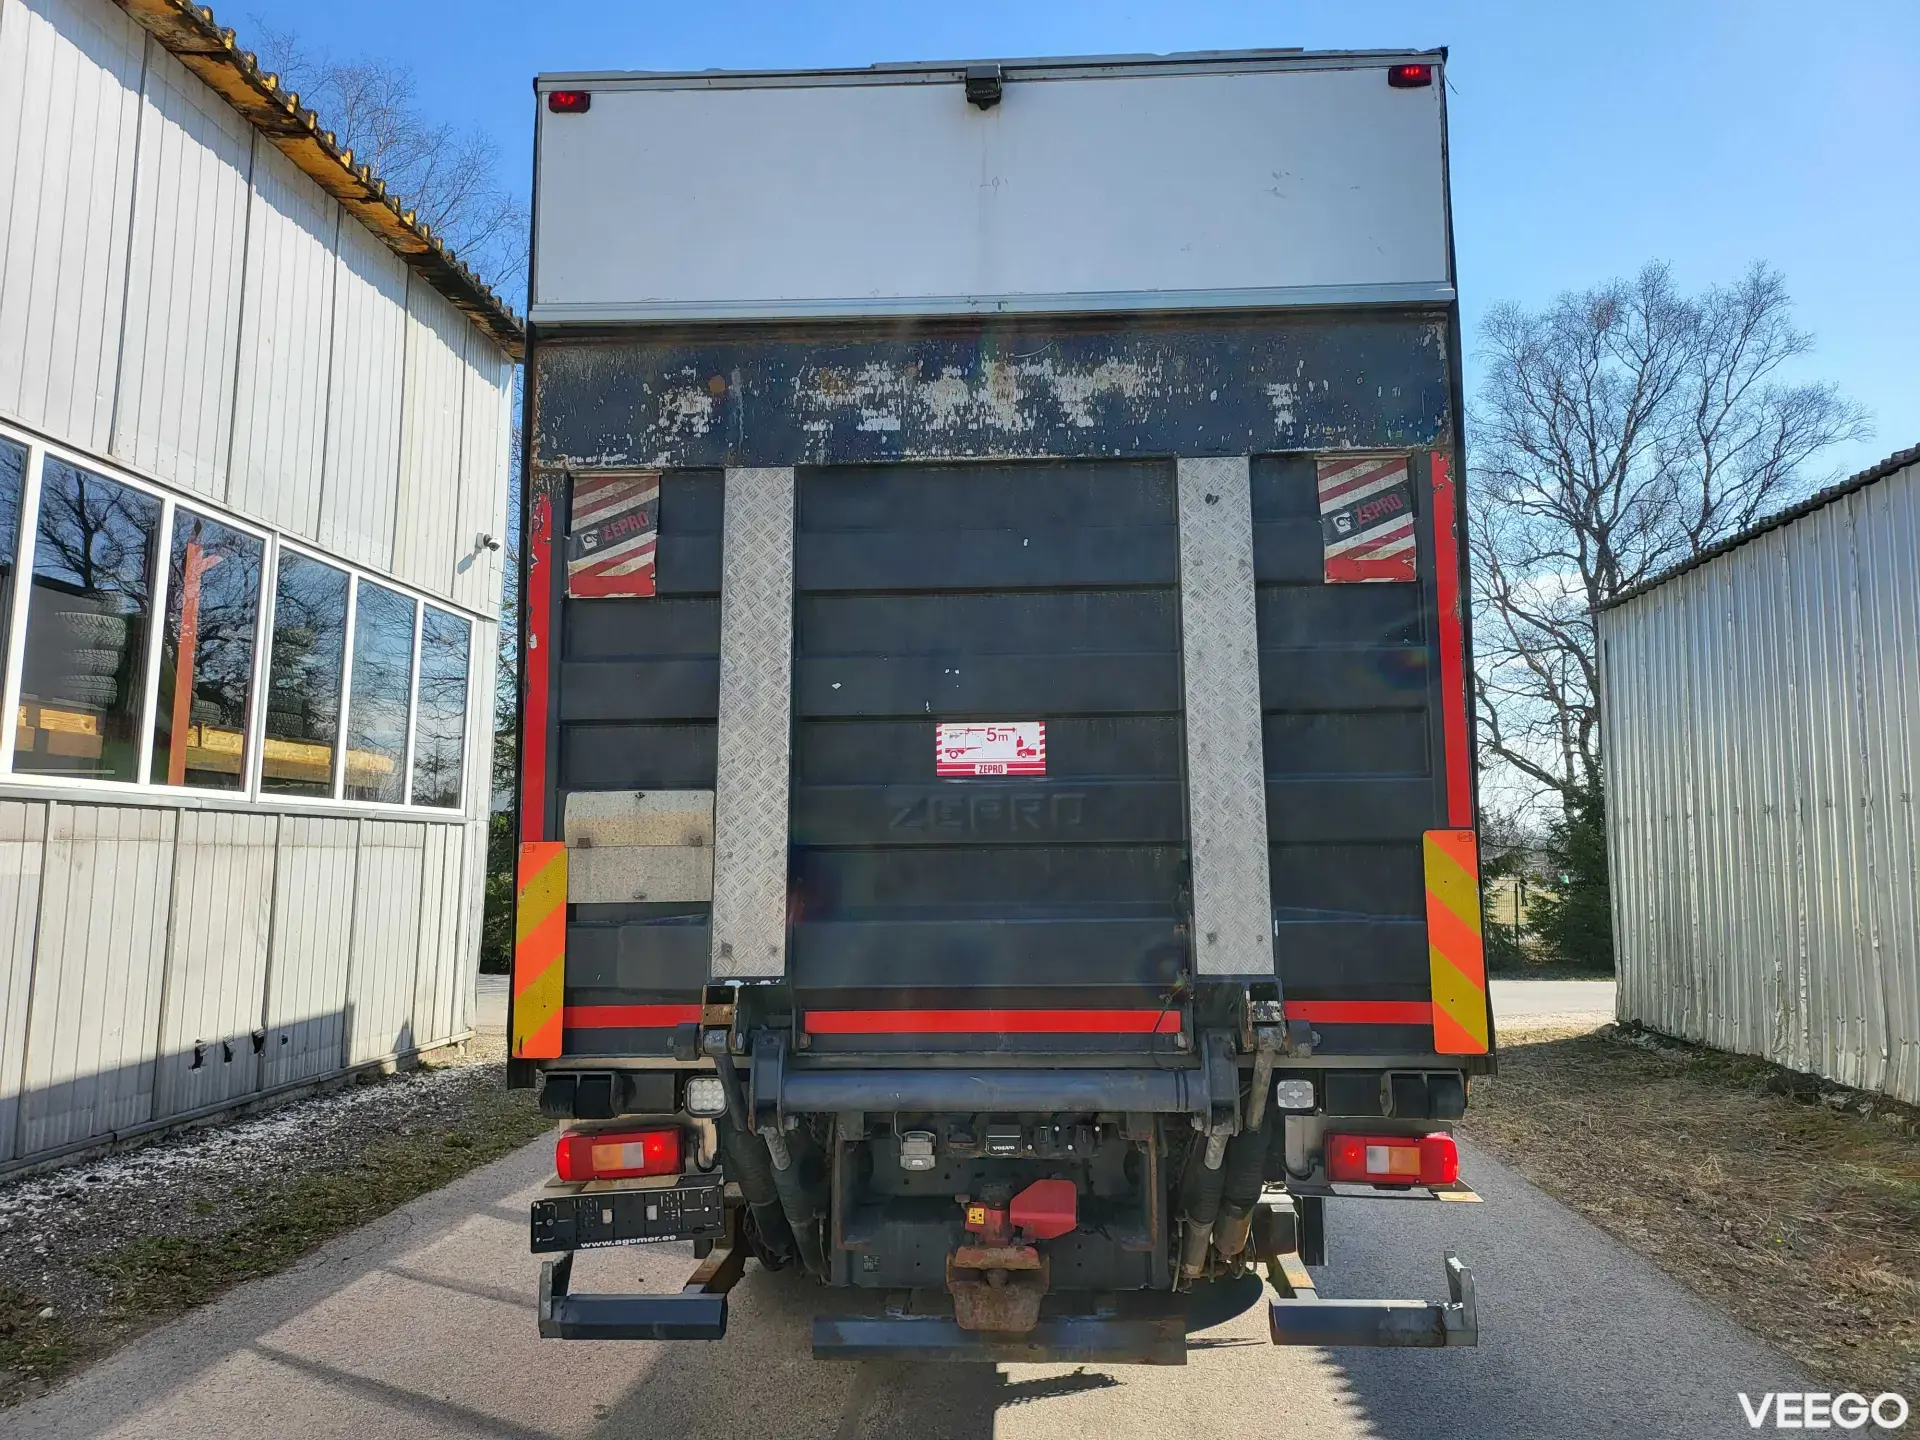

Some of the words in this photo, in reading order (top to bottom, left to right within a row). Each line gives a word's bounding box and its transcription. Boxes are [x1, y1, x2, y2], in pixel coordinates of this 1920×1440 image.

[1354, 493, 1403, 524] ZEPRO
[600, 509, 650, 541] ZEPRO
[986, 727, 997, 742] 5
[998, 733, 1009, 742] m
[978, 764, 1004, 774] ZEPRO
[580, 1233, 677, 1249] www.agomer.ee
